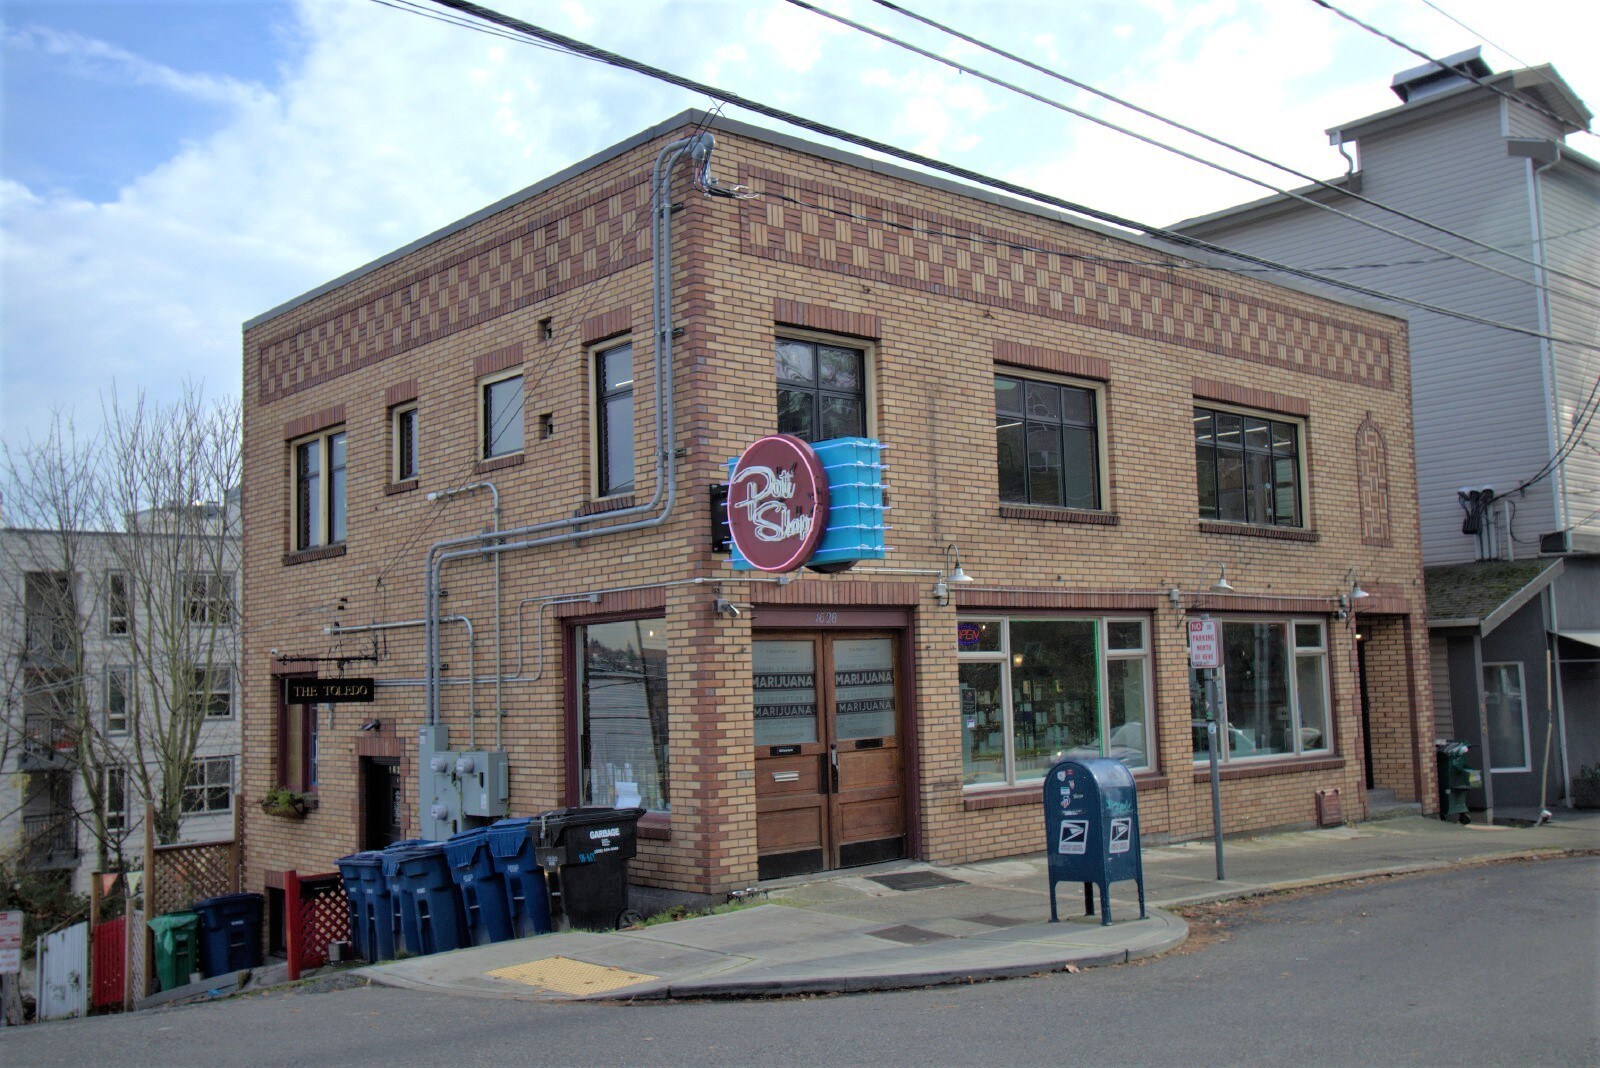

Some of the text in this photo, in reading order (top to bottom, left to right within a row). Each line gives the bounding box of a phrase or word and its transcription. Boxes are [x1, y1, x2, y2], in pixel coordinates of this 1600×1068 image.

[753, 500, 813, 542] Shop
[815, 611, 838, 625] 1628
[1191, 622, 1201, 631] NO
[1192, 633, 1215, 642] PARKING
[1196, 644, 1212, 652] NORTH
[752, 674, 814, 689] MARIJUANA
[835, 671, 892, 686] MARIJUANA
[293, 685, 368, 697] THE TOLEDO
[754, 704, 813, 718] MARIJUANA
[839, 699, 892, 713] MARIJUANA
[589, 827, 621, 840] GARBAGE
